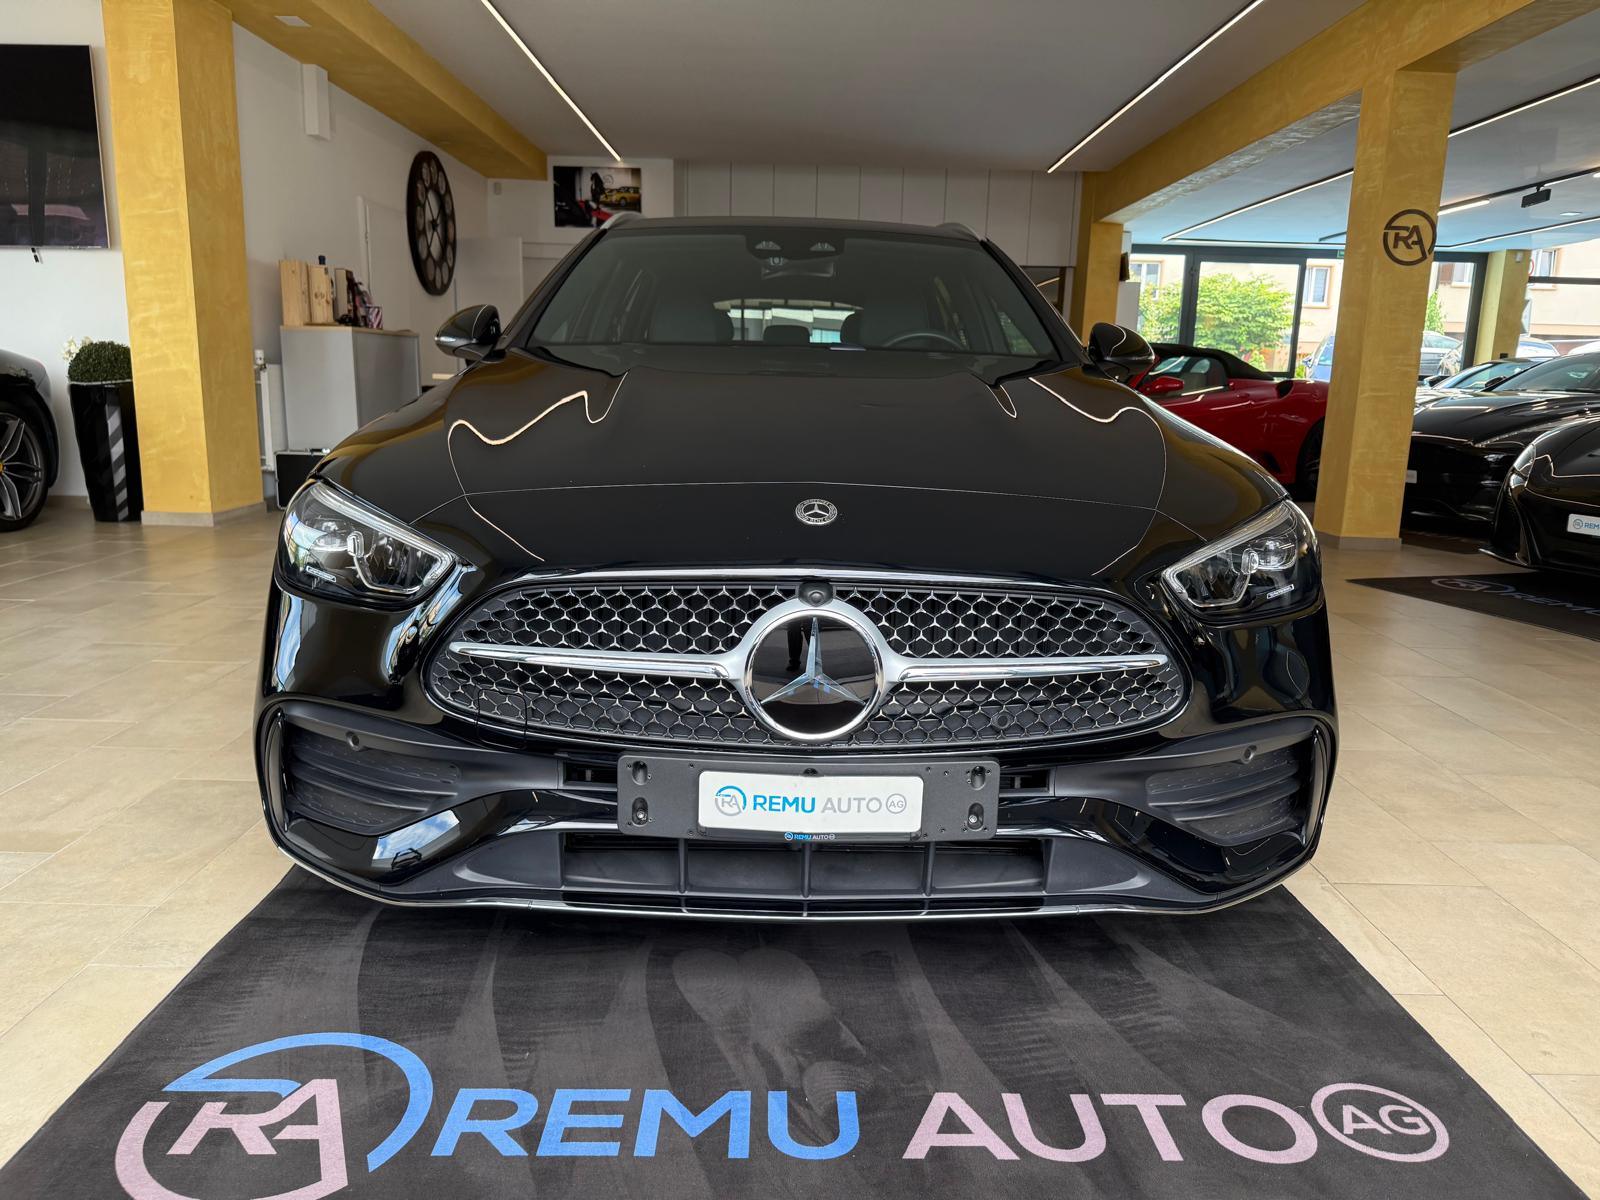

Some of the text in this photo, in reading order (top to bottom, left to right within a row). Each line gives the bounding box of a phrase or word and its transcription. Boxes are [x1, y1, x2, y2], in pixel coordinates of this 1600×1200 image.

[752, 794, 816, 813] REMU
[820, 796, 883, 814] AUTO
[430, 1086, 861, 1161] REMU
[901, 1092, 1319, 1165] AUTO
[1342, 1104, 1431, 1136] AG
